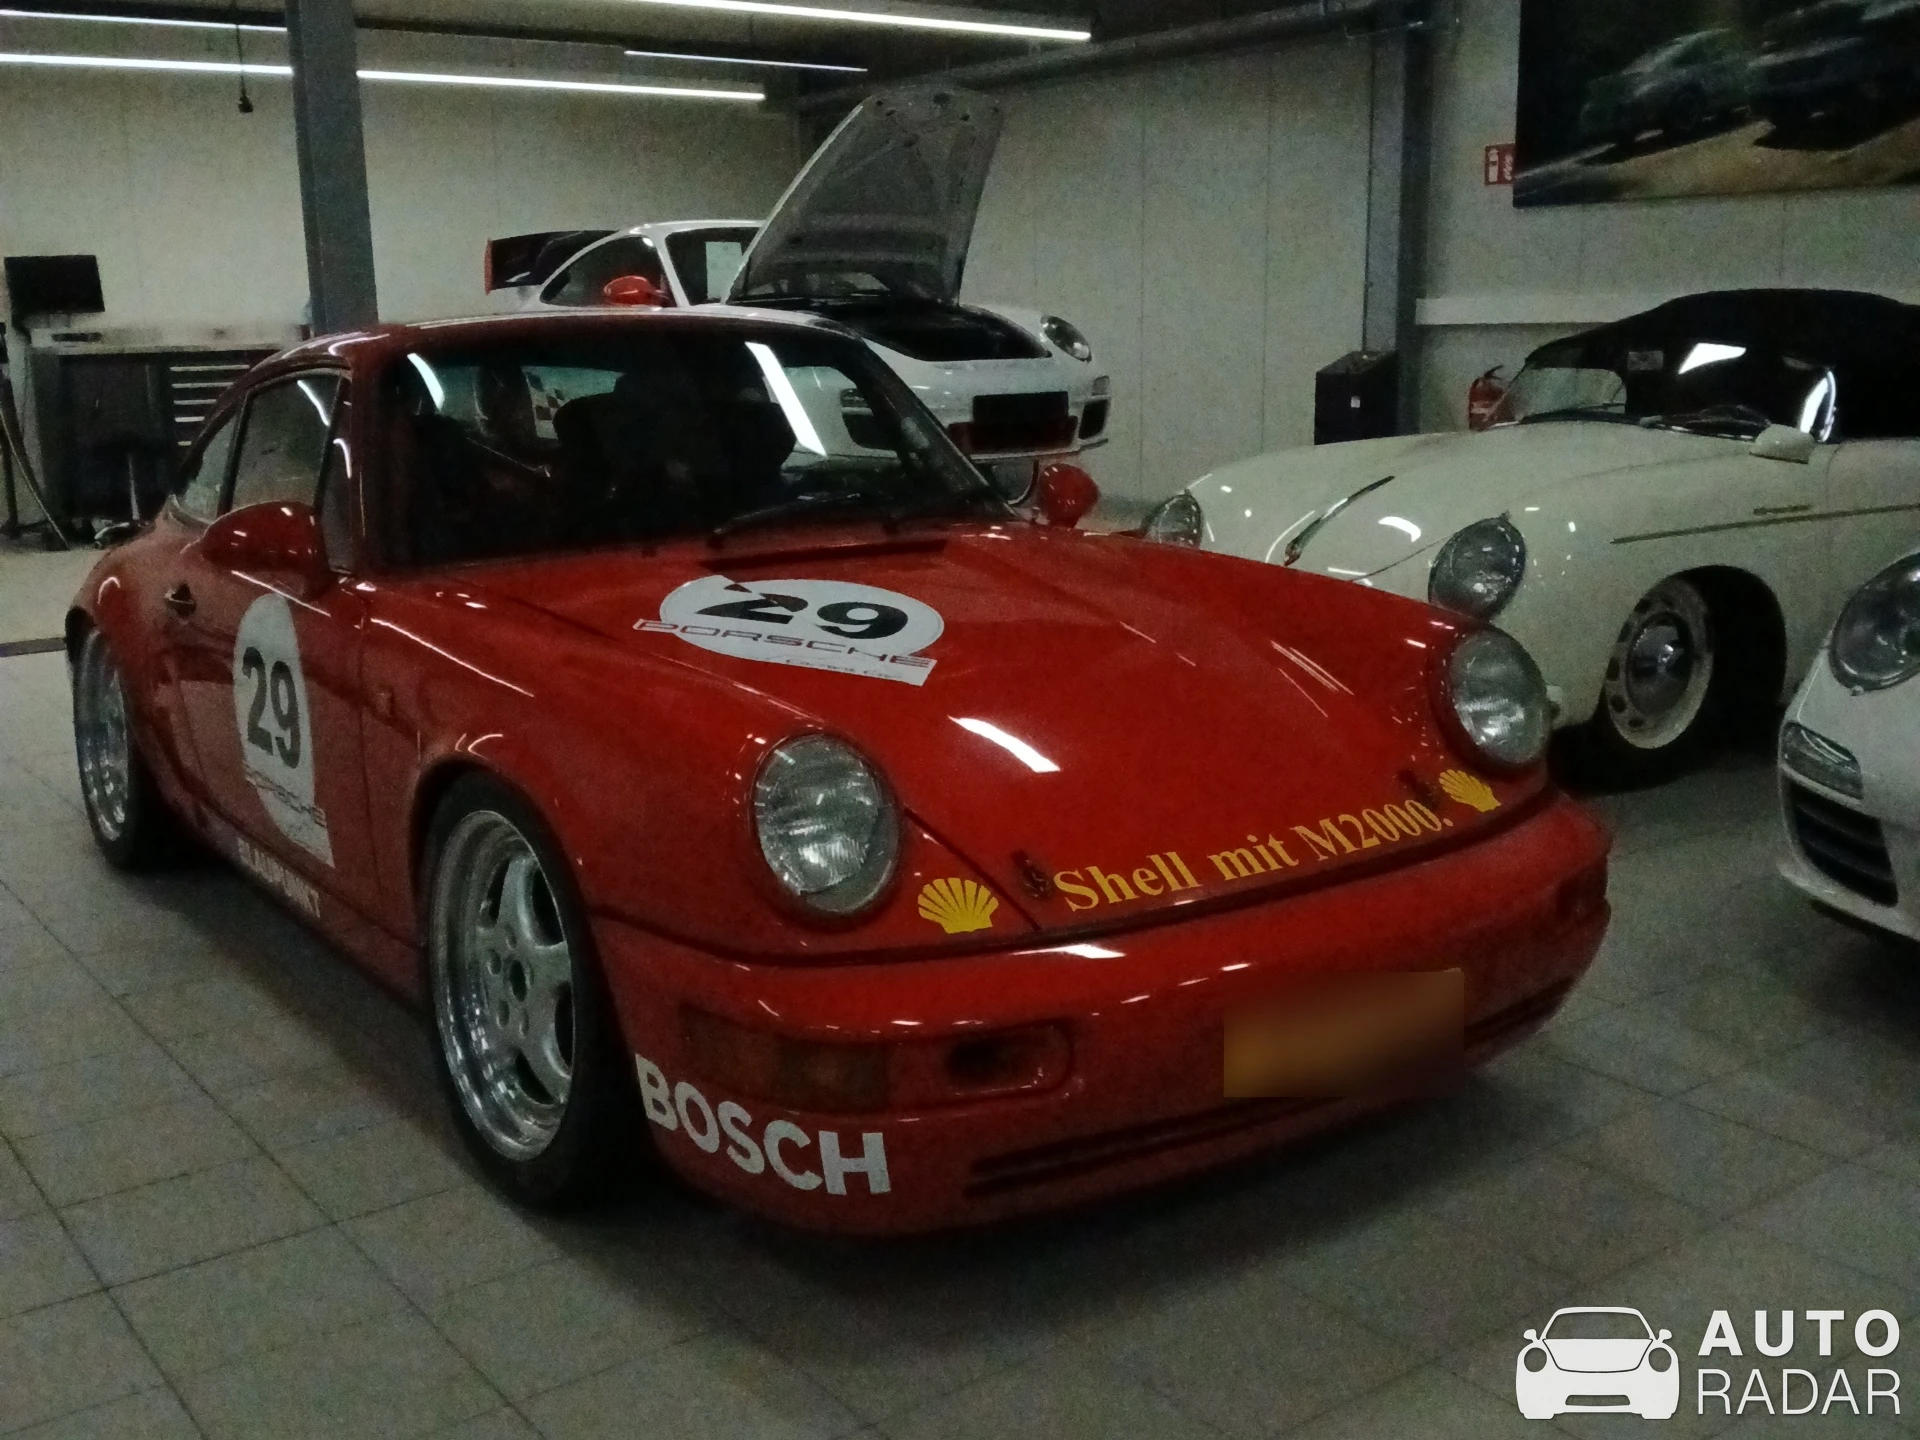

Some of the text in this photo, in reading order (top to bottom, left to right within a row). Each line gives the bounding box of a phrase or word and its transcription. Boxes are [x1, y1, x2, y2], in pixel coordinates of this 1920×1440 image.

[637, 622, 930, 668] PORSCHE
[694, 583, 908, 639] 29
[242, 646, 301, 769] 29
[1053, 799, 1454, 912] Shell mit M2000.
[635, 1053, 892, 1195] BOSCH
